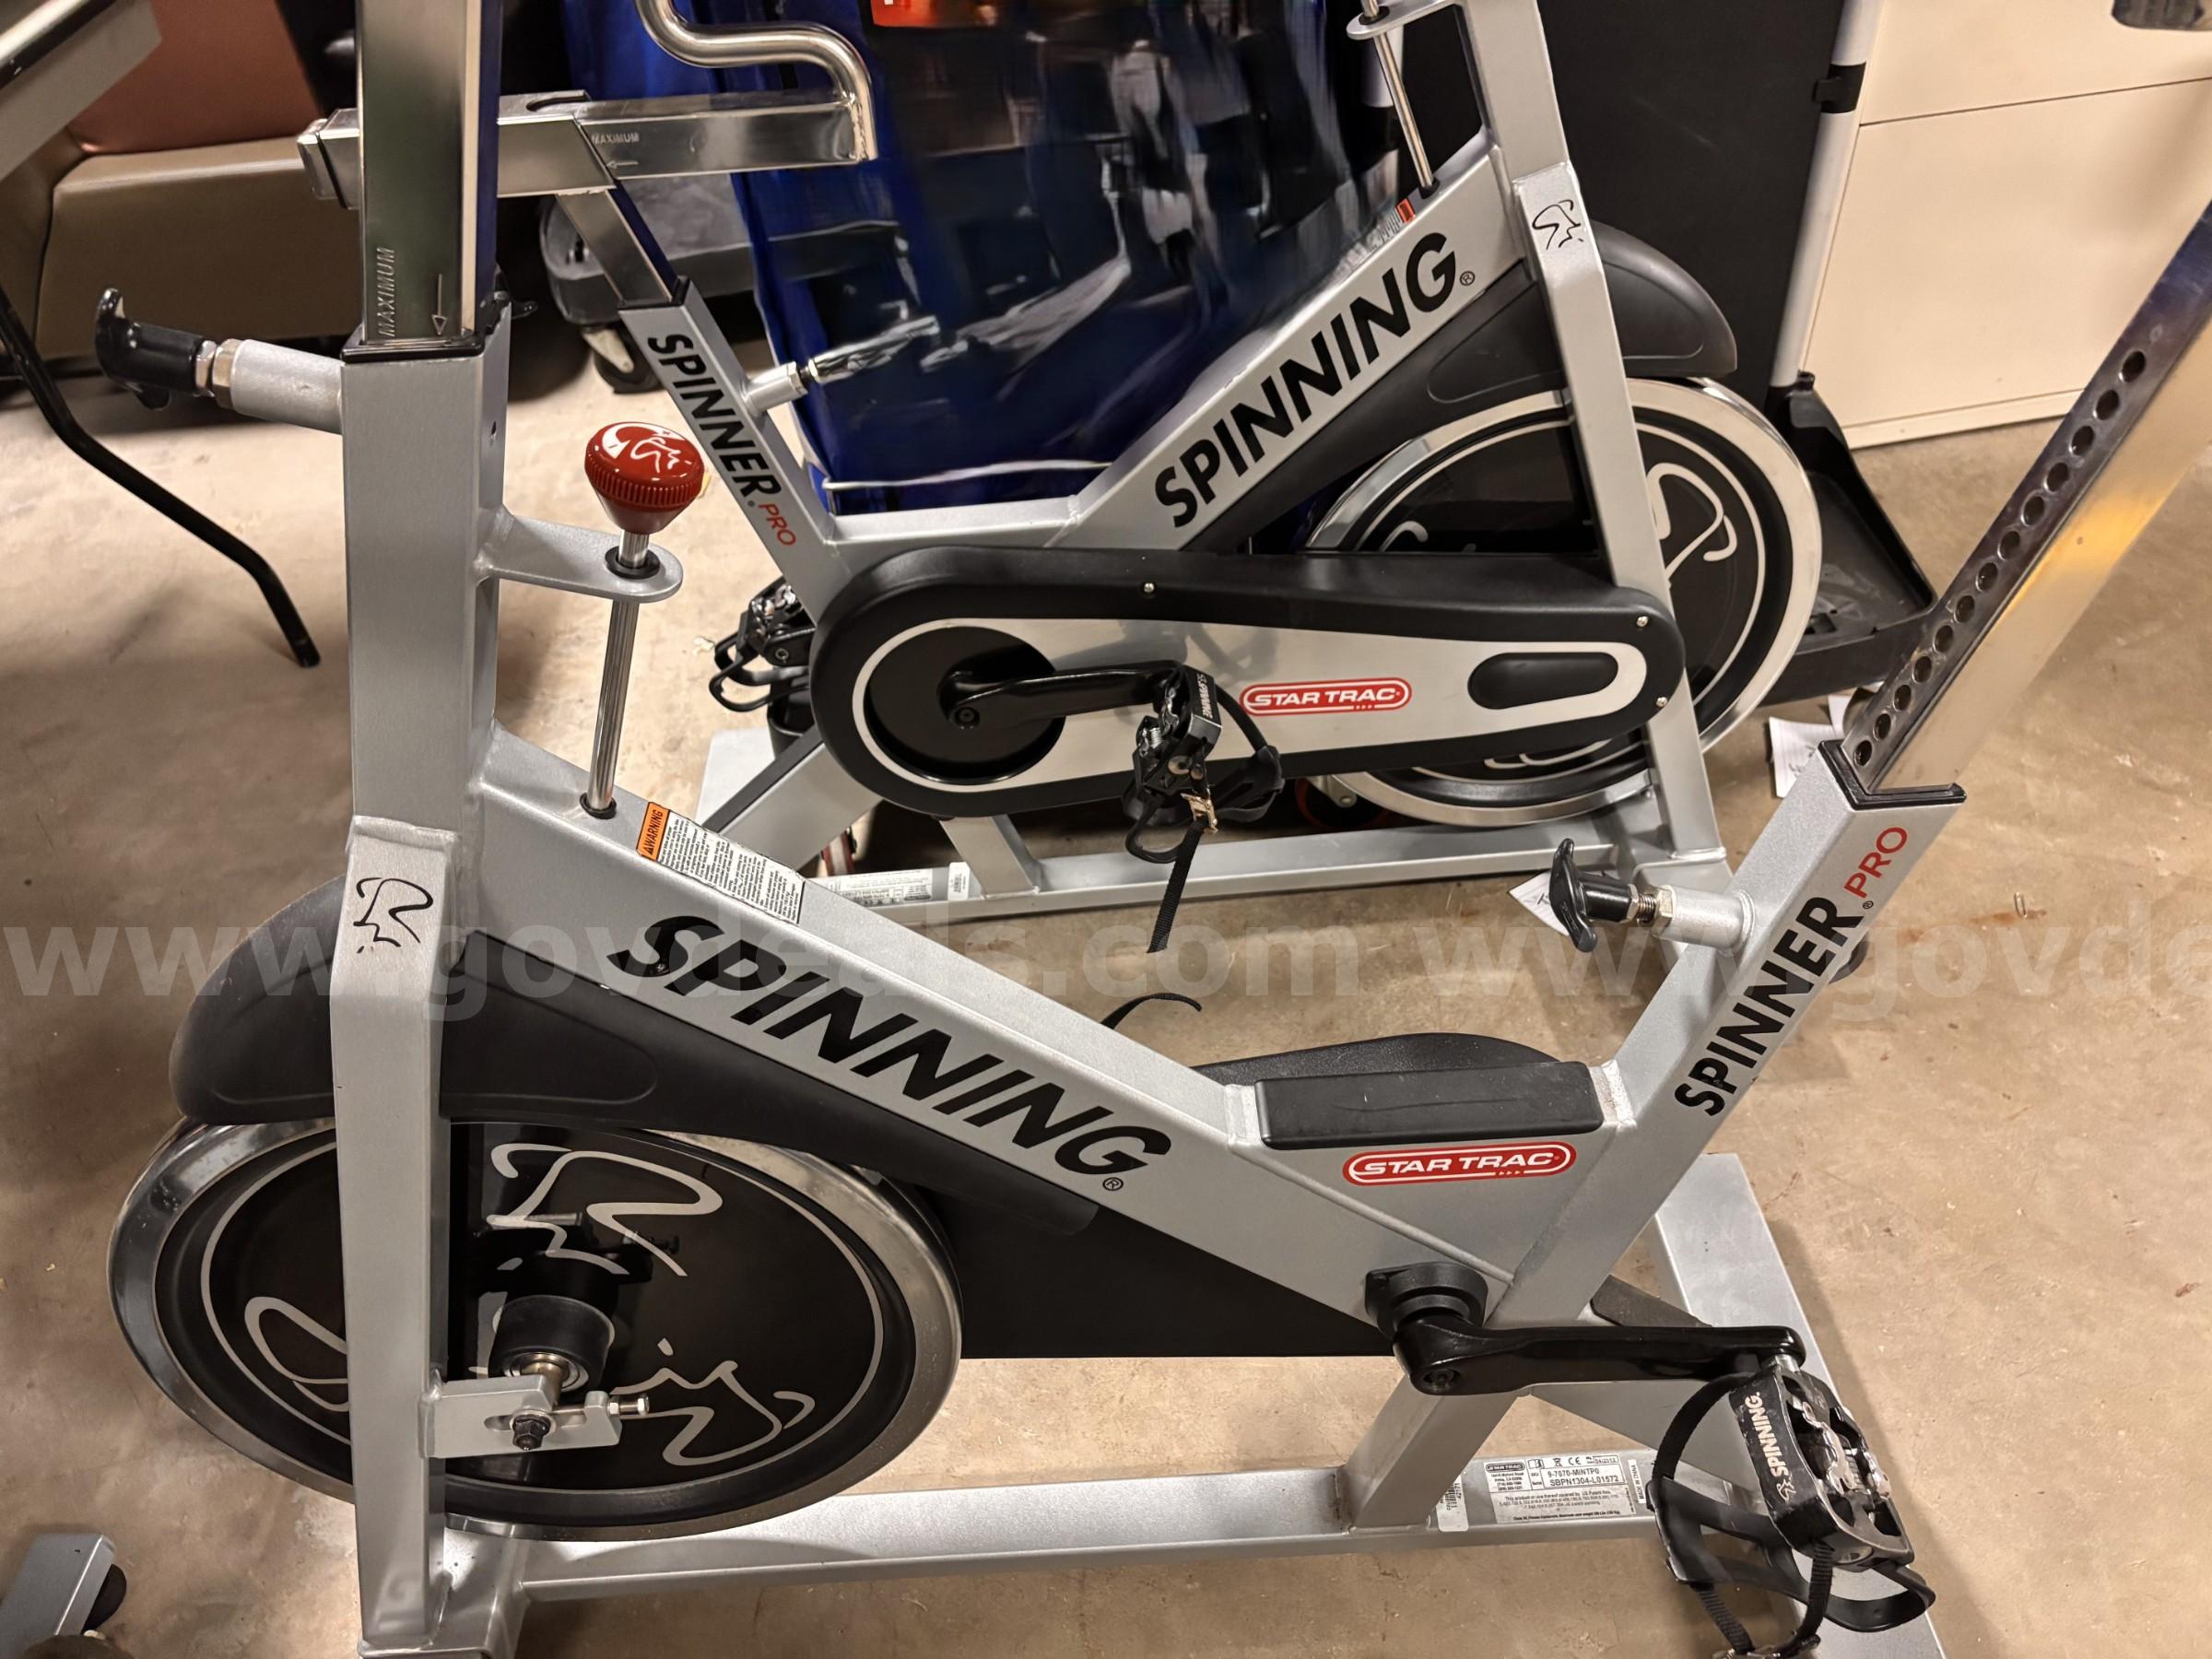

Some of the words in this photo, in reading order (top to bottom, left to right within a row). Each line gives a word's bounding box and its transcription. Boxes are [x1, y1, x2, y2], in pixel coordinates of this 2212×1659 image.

[592, 132, 640, 145] MAXIMUM
[376, 246, 396, 337] MAXIMUM
[759, 503, 796, 547] PRO
[1254, 691, 1321, 707] STAR
[1324, 688, 1396, 704] TRAC
[644, 809, 664, 849] WARNING
[1843, 827, 1909, 899] PRO
[1364, 1158, 1453, 1174] STAR
[1459, 1152, 1554, 1171] TRAC
